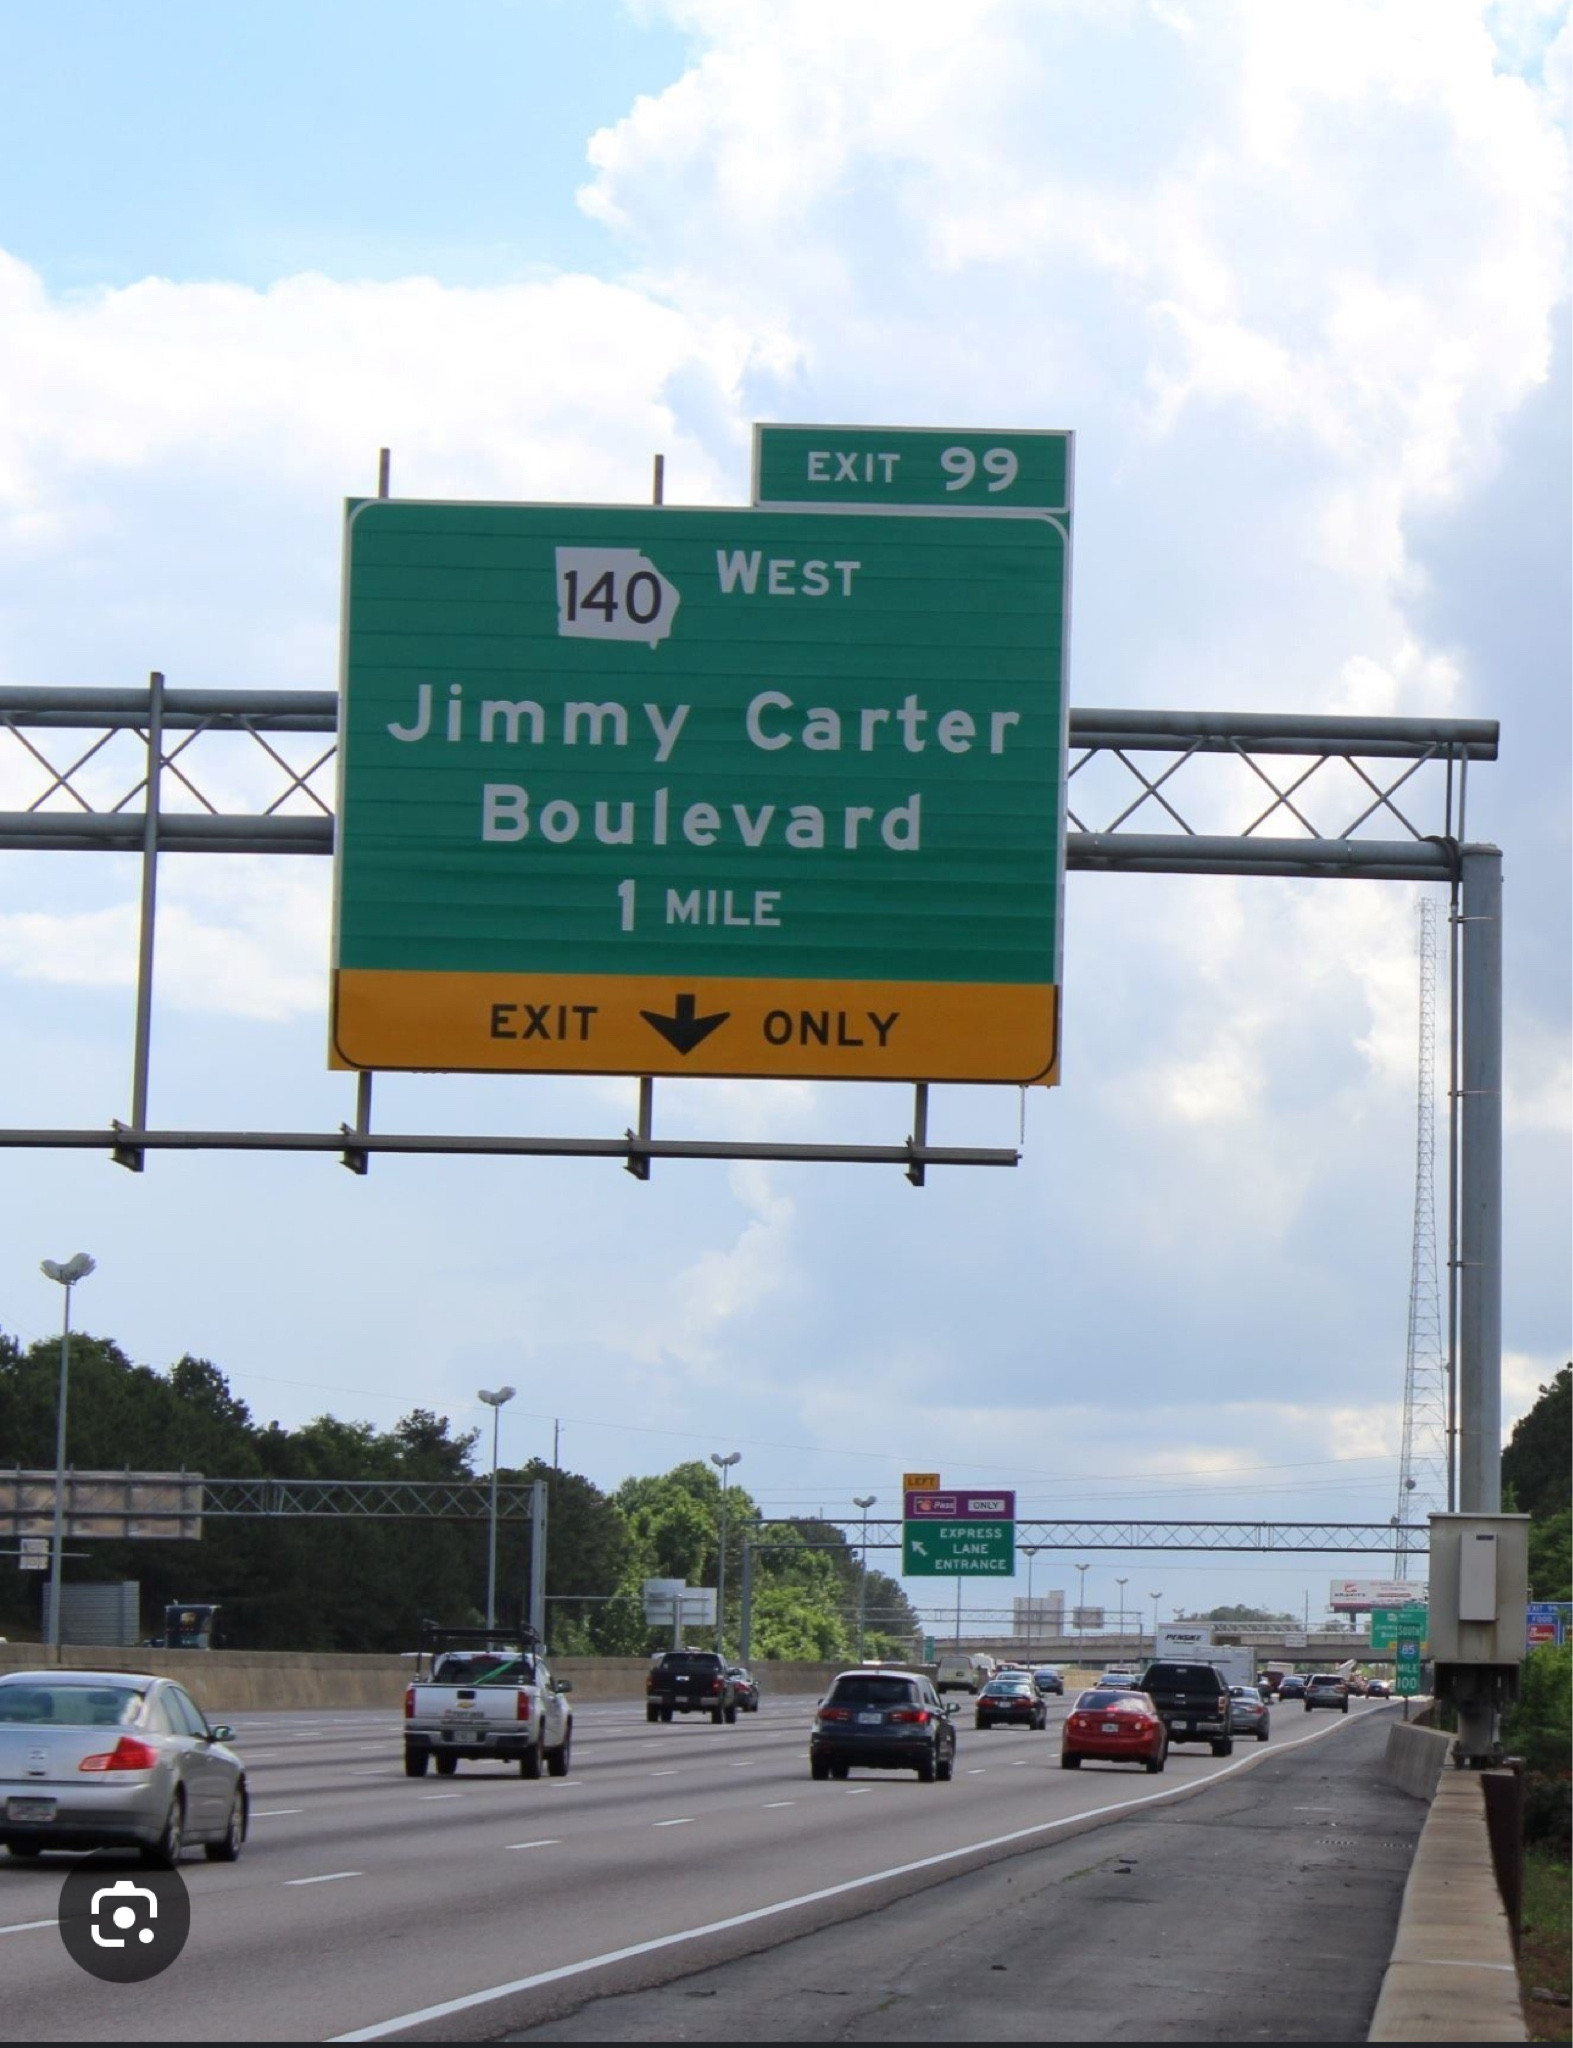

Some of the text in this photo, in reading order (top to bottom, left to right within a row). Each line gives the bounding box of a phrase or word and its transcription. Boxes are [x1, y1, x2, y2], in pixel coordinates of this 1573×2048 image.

[807, 446, 1019, 492] EXIT 99
[563, 569, 663, 625] 140
[387, 683, 1021, 762] Jimmy Carter
[482, 783, 921, 851] Boulevard
[617, 879, 781, 932] 1 MILE
[490, 1003, 900, 1047] EXIT ONLY
[907, 1476, 935, 1486] LEFT
[973, 1501, 999, 1510] ONLY
[940, 1528, 1003, 1538] EXPRESS
[952, 1543, 989, 1554] LANE
[934, 1559, 1007, 1570] ENTRANCE
[1401, 1645, 1416, 1655] 85
[1397, 1663, 1419, 1673] MILE
[1397, 1676, 1418, 1689] 100
